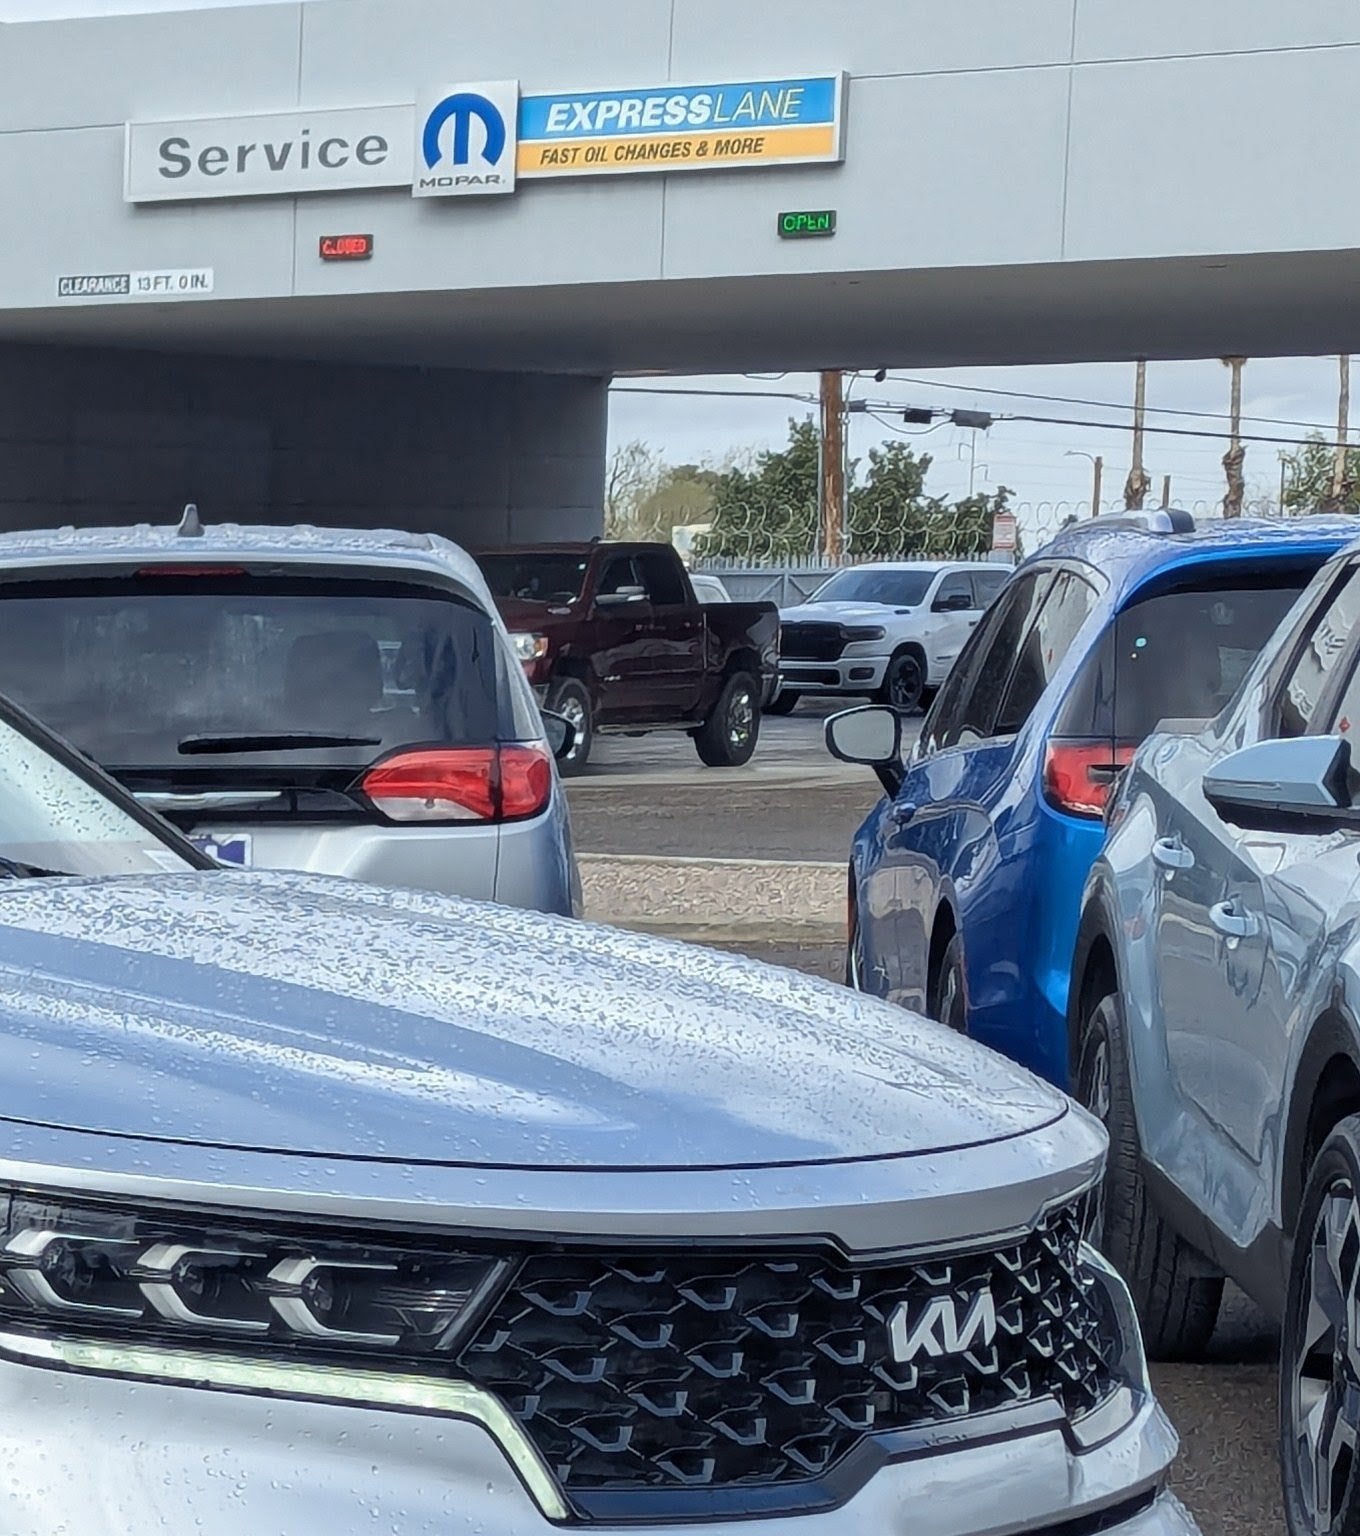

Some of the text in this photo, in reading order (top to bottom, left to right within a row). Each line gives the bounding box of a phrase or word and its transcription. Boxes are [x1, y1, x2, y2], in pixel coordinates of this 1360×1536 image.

[158, 128, 388, 179] Service
[540, 137, 765, 166] FAST OIL CHANGES & MORE
[419, 174, 501, 188] MOPAR
[783, 213, 829, 231] OPEN
[60, 275, 129, 295] CLEARANCE
[138, 276, 151, 291] 13
